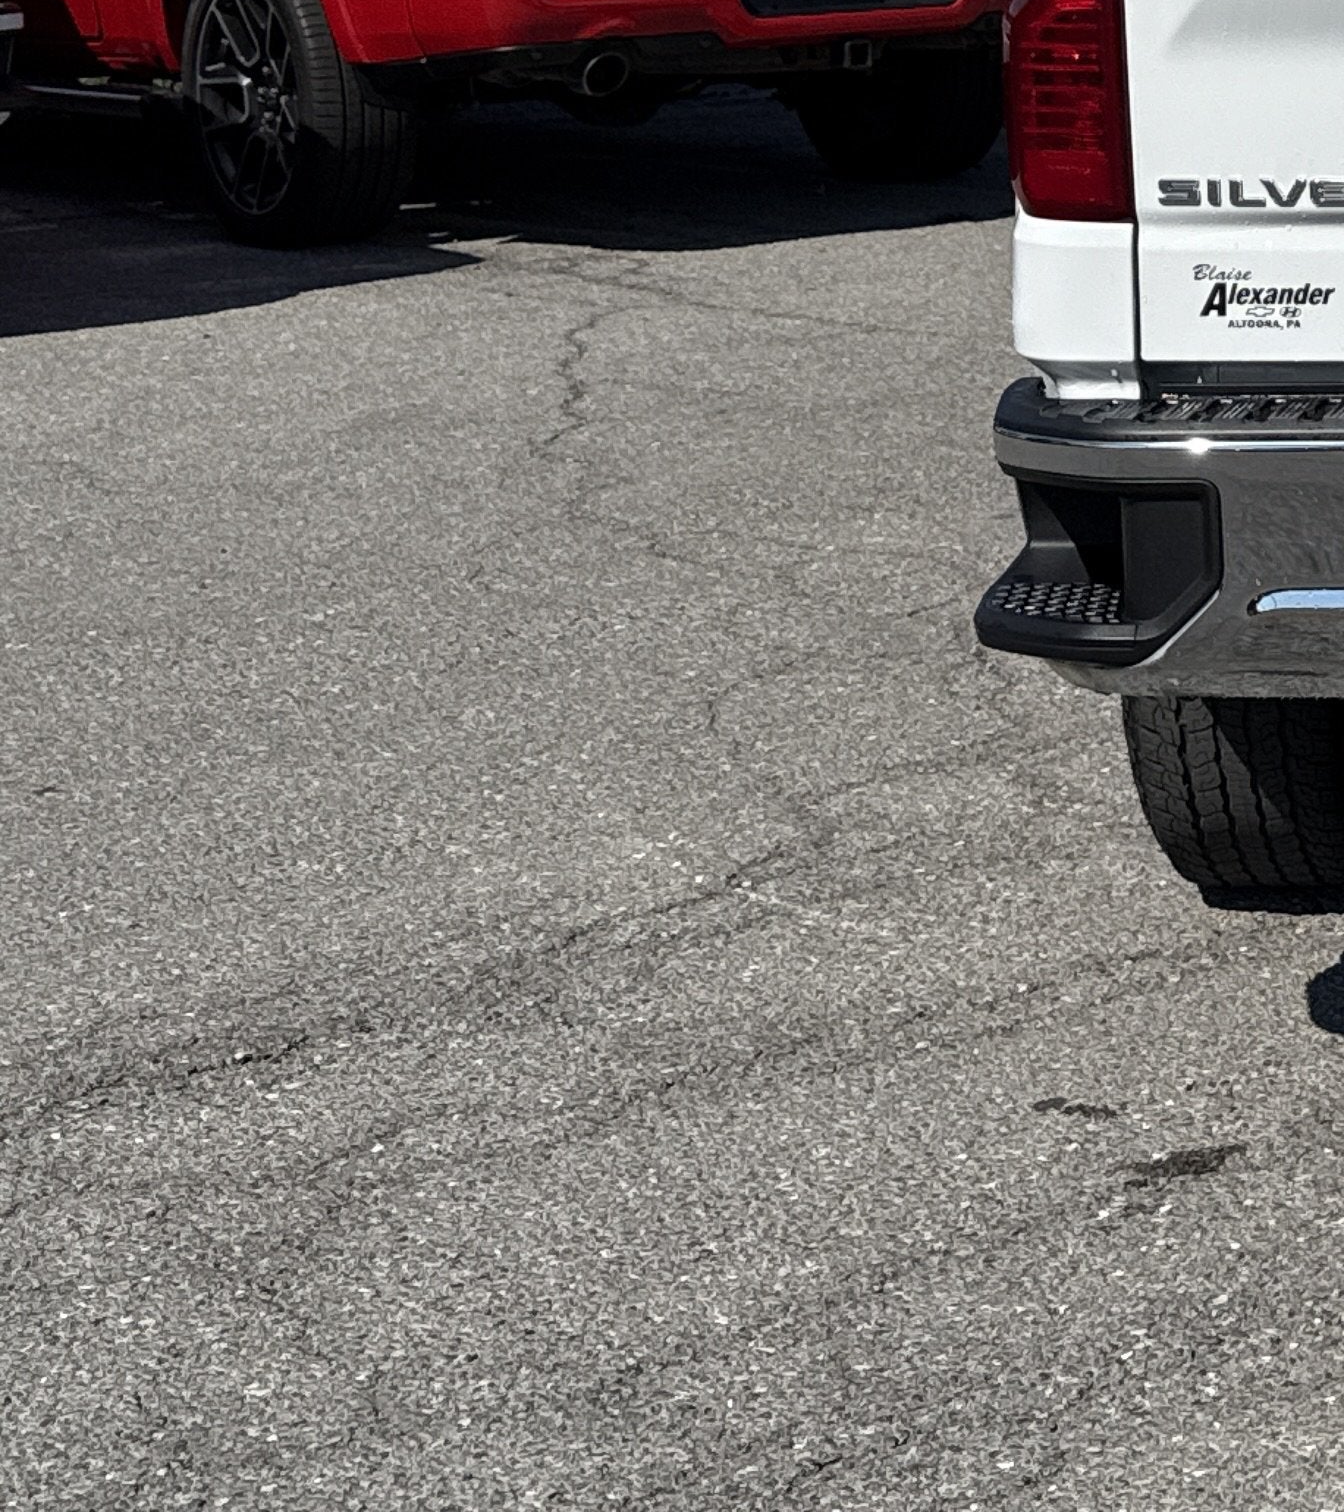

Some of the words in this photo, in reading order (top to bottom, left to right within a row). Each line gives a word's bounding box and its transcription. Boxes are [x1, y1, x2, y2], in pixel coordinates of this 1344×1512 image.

[1191, 262, 1254, 281] Blaise
[1199, 281, 1336, 317] Alexander
[1286, 319, 1301, 329] PA
